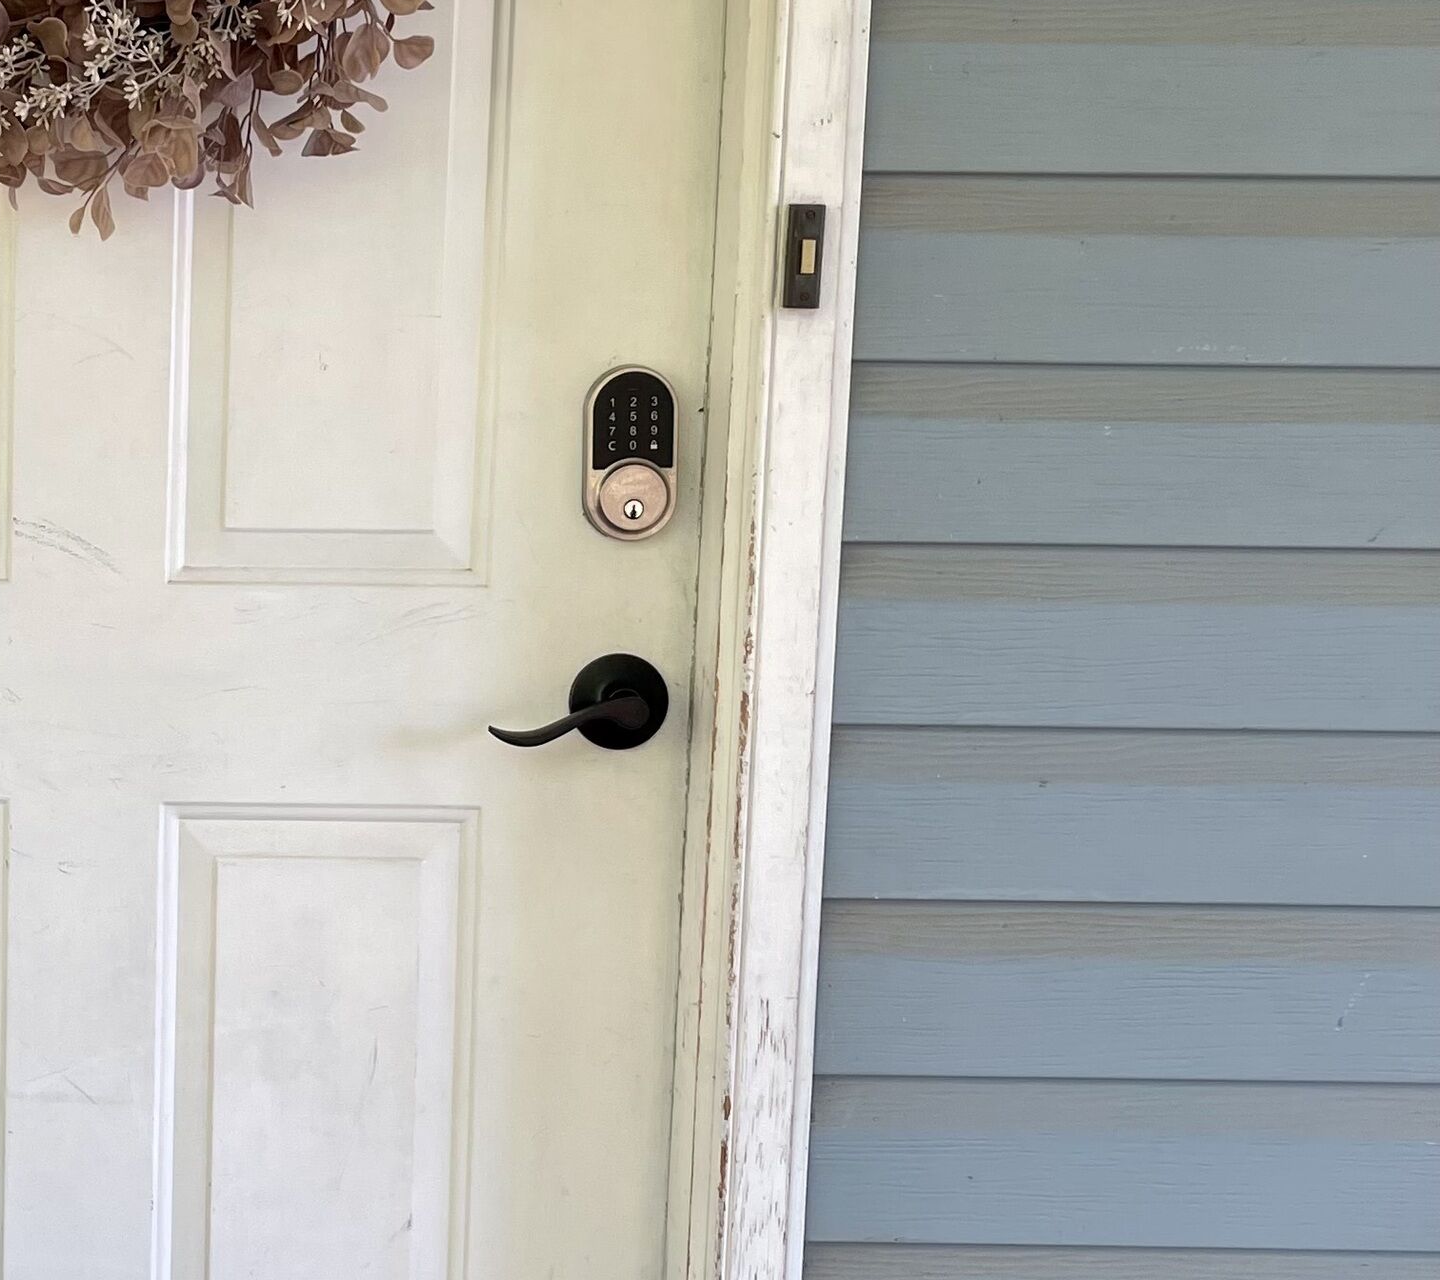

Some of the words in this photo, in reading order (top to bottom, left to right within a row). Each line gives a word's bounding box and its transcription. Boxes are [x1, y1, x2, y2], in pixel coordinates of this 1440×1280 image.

[609, 397, 616, 408] 1
[629, 396, 638, 408] 2
[650, 395, 659, 407] 3
[608, 411, 616, 422] 4
[629, 411, 638, 422] 5
[650, 410, 659, 421] 6
[608, 426, 617, 437] 7
[629, 425, 638, 437] 8
[650, 424, 659, 436] 9
[607, 440, 617, 451] C
[629, 440, 638, 451] 0
